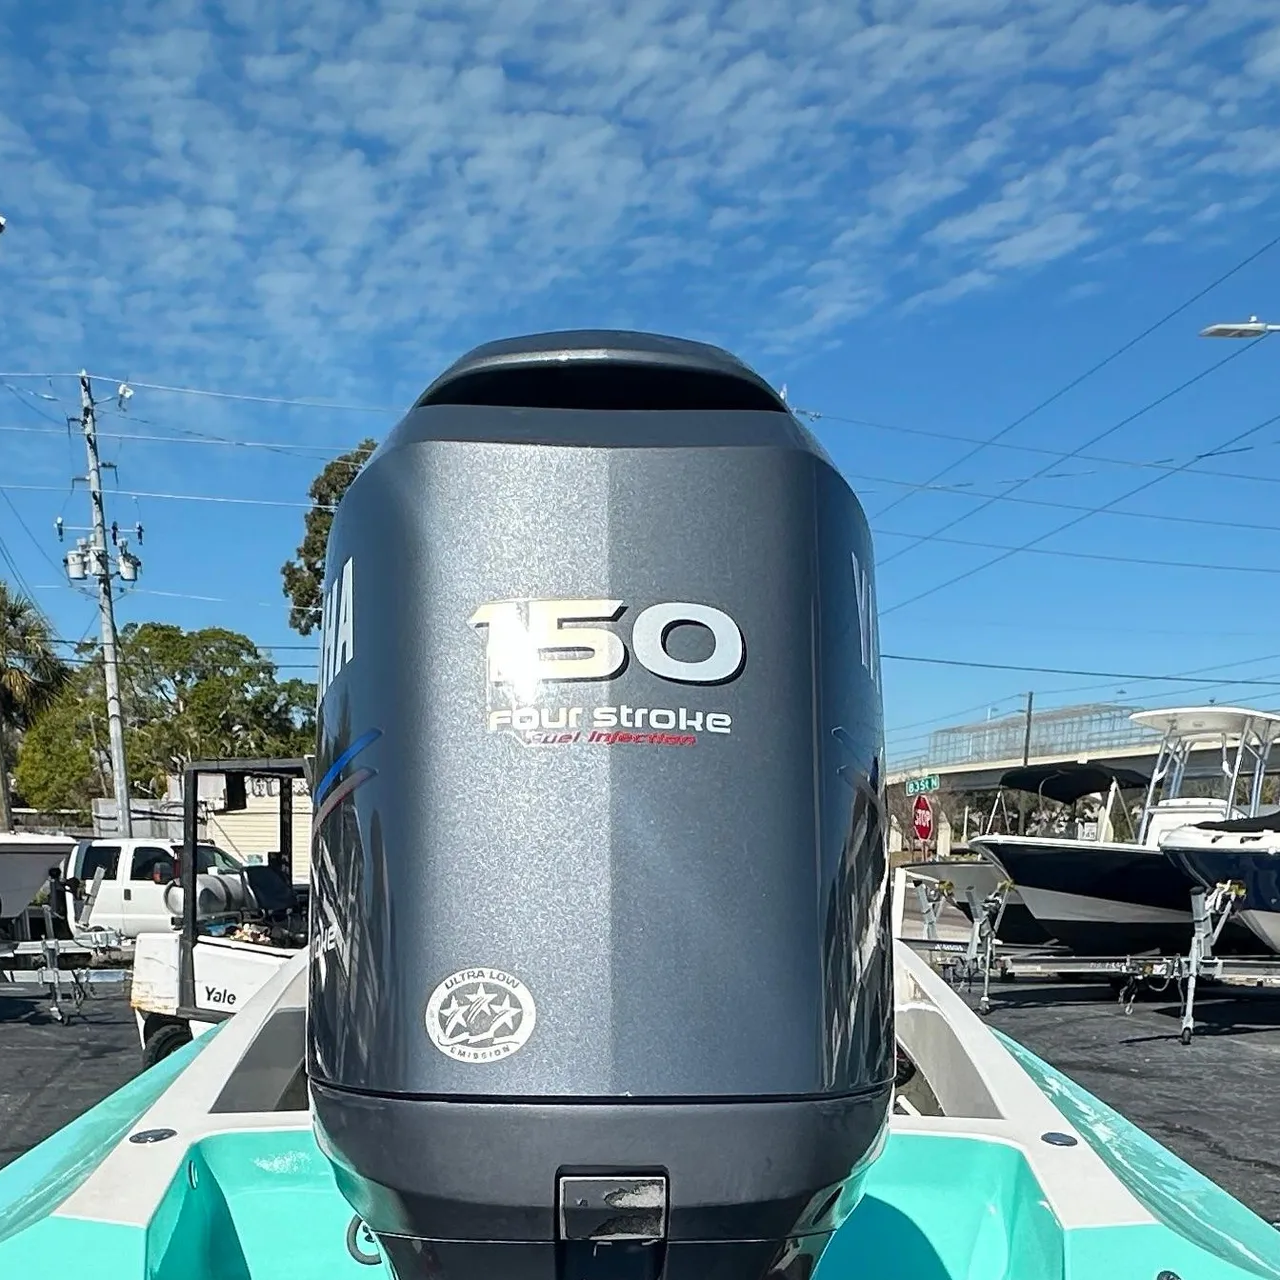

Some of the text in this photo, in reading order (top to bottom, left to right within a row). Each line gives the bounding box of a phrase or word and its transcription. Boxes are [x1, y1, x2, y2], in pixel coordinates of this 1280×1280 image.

[470, 599, 746, 685] 150
[588, 730, 697, 747] Injection
[931, 777, 937, 788] N
[915, 809, 930, 827] STOP
[445, 970, 519, 989] ULTRA LOW
[205, 985, 237, 1005] Yale
[450, 1045, 510, 1060] EMISSION
